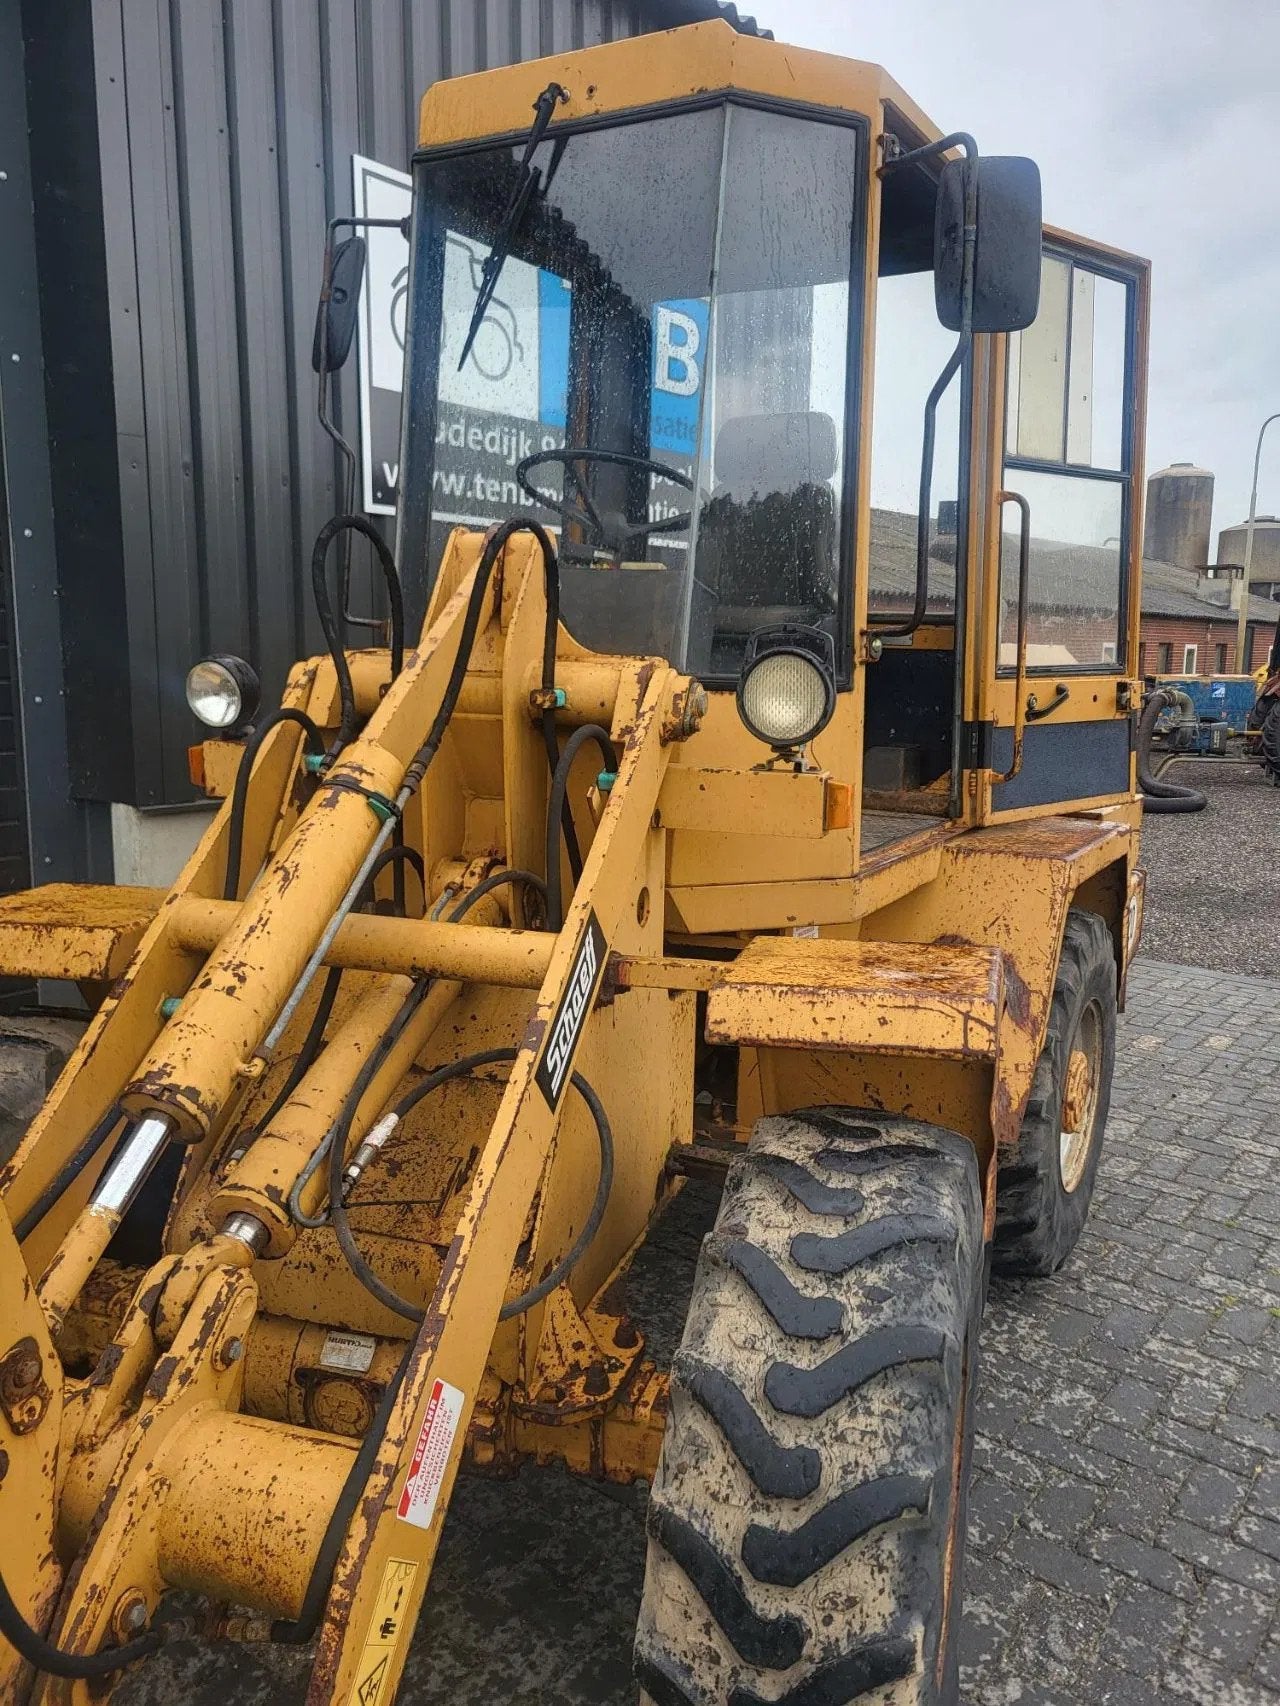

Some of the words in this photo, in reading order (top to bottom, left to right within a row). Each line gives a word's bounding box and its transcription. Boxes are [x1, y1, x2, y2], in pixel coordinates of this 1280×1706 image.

[655, 305, 700, 396] B
[435, 420, 532, 466] udedijk
[654, 416, 698, 442] satie
[414, 1397, 437, 1462] GEFAHR
[419, 1412, 441, 1480] AUFENTHALT
[439, 1397, 445, 1411] IM
[434, 1430, 452, 1485] VERBOTEN
